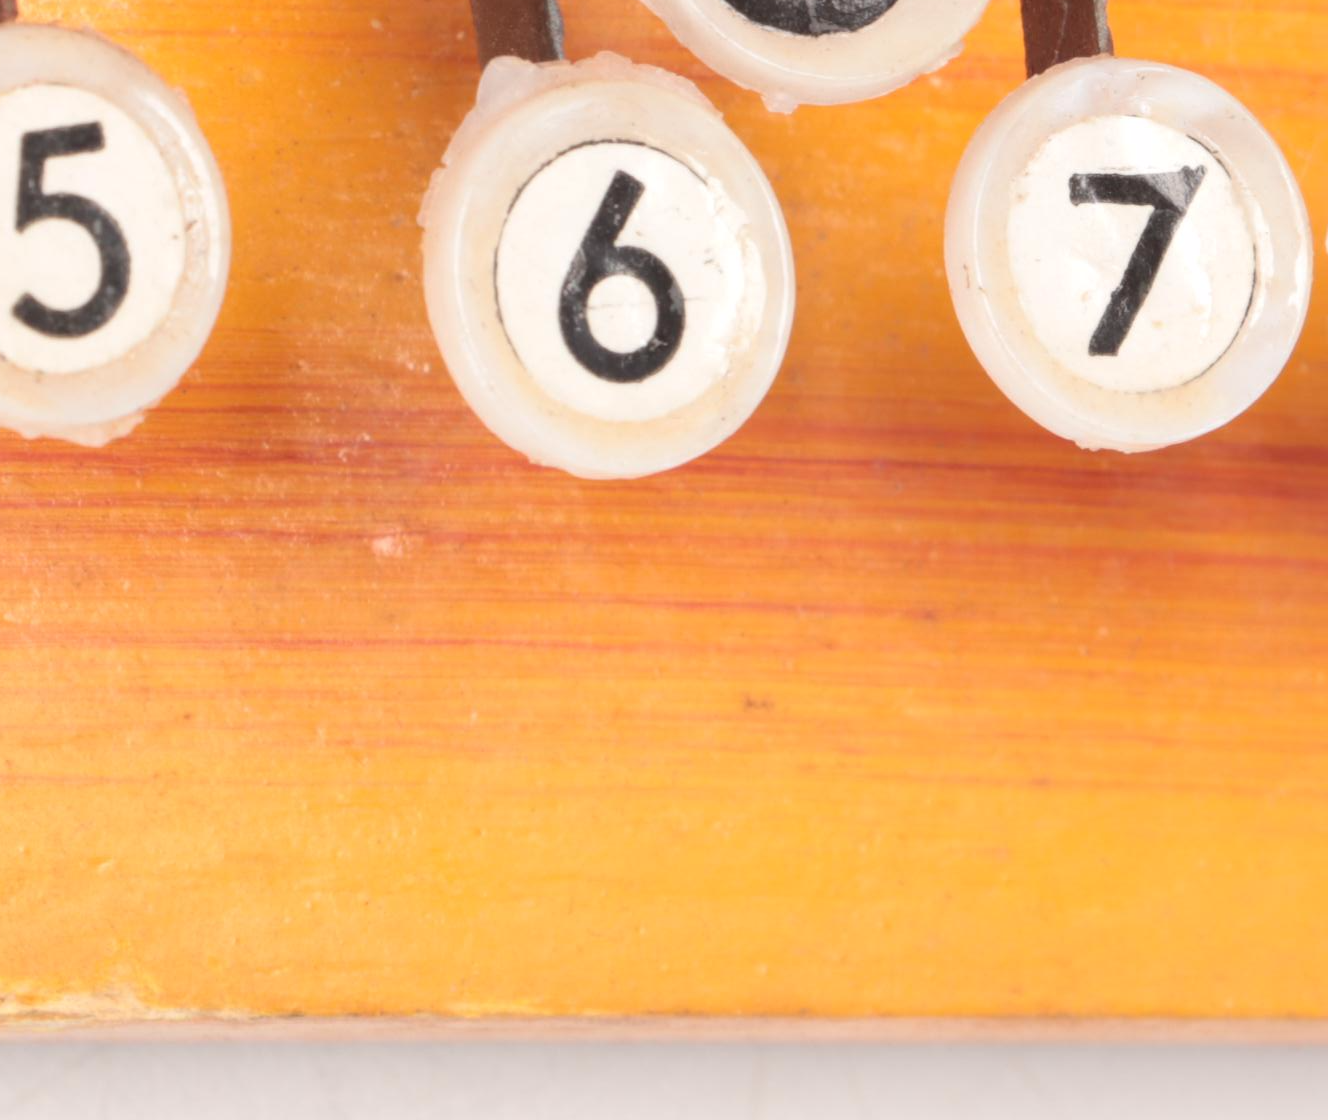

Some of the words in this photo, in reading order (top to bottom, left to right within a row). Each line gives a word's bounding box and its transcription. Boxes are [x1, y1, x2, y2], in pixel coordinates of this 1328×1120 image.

[12, 121, 132, 340] 5
[558, 169, 686, 384] 6
[1068, 164, 1207, 357] 7
